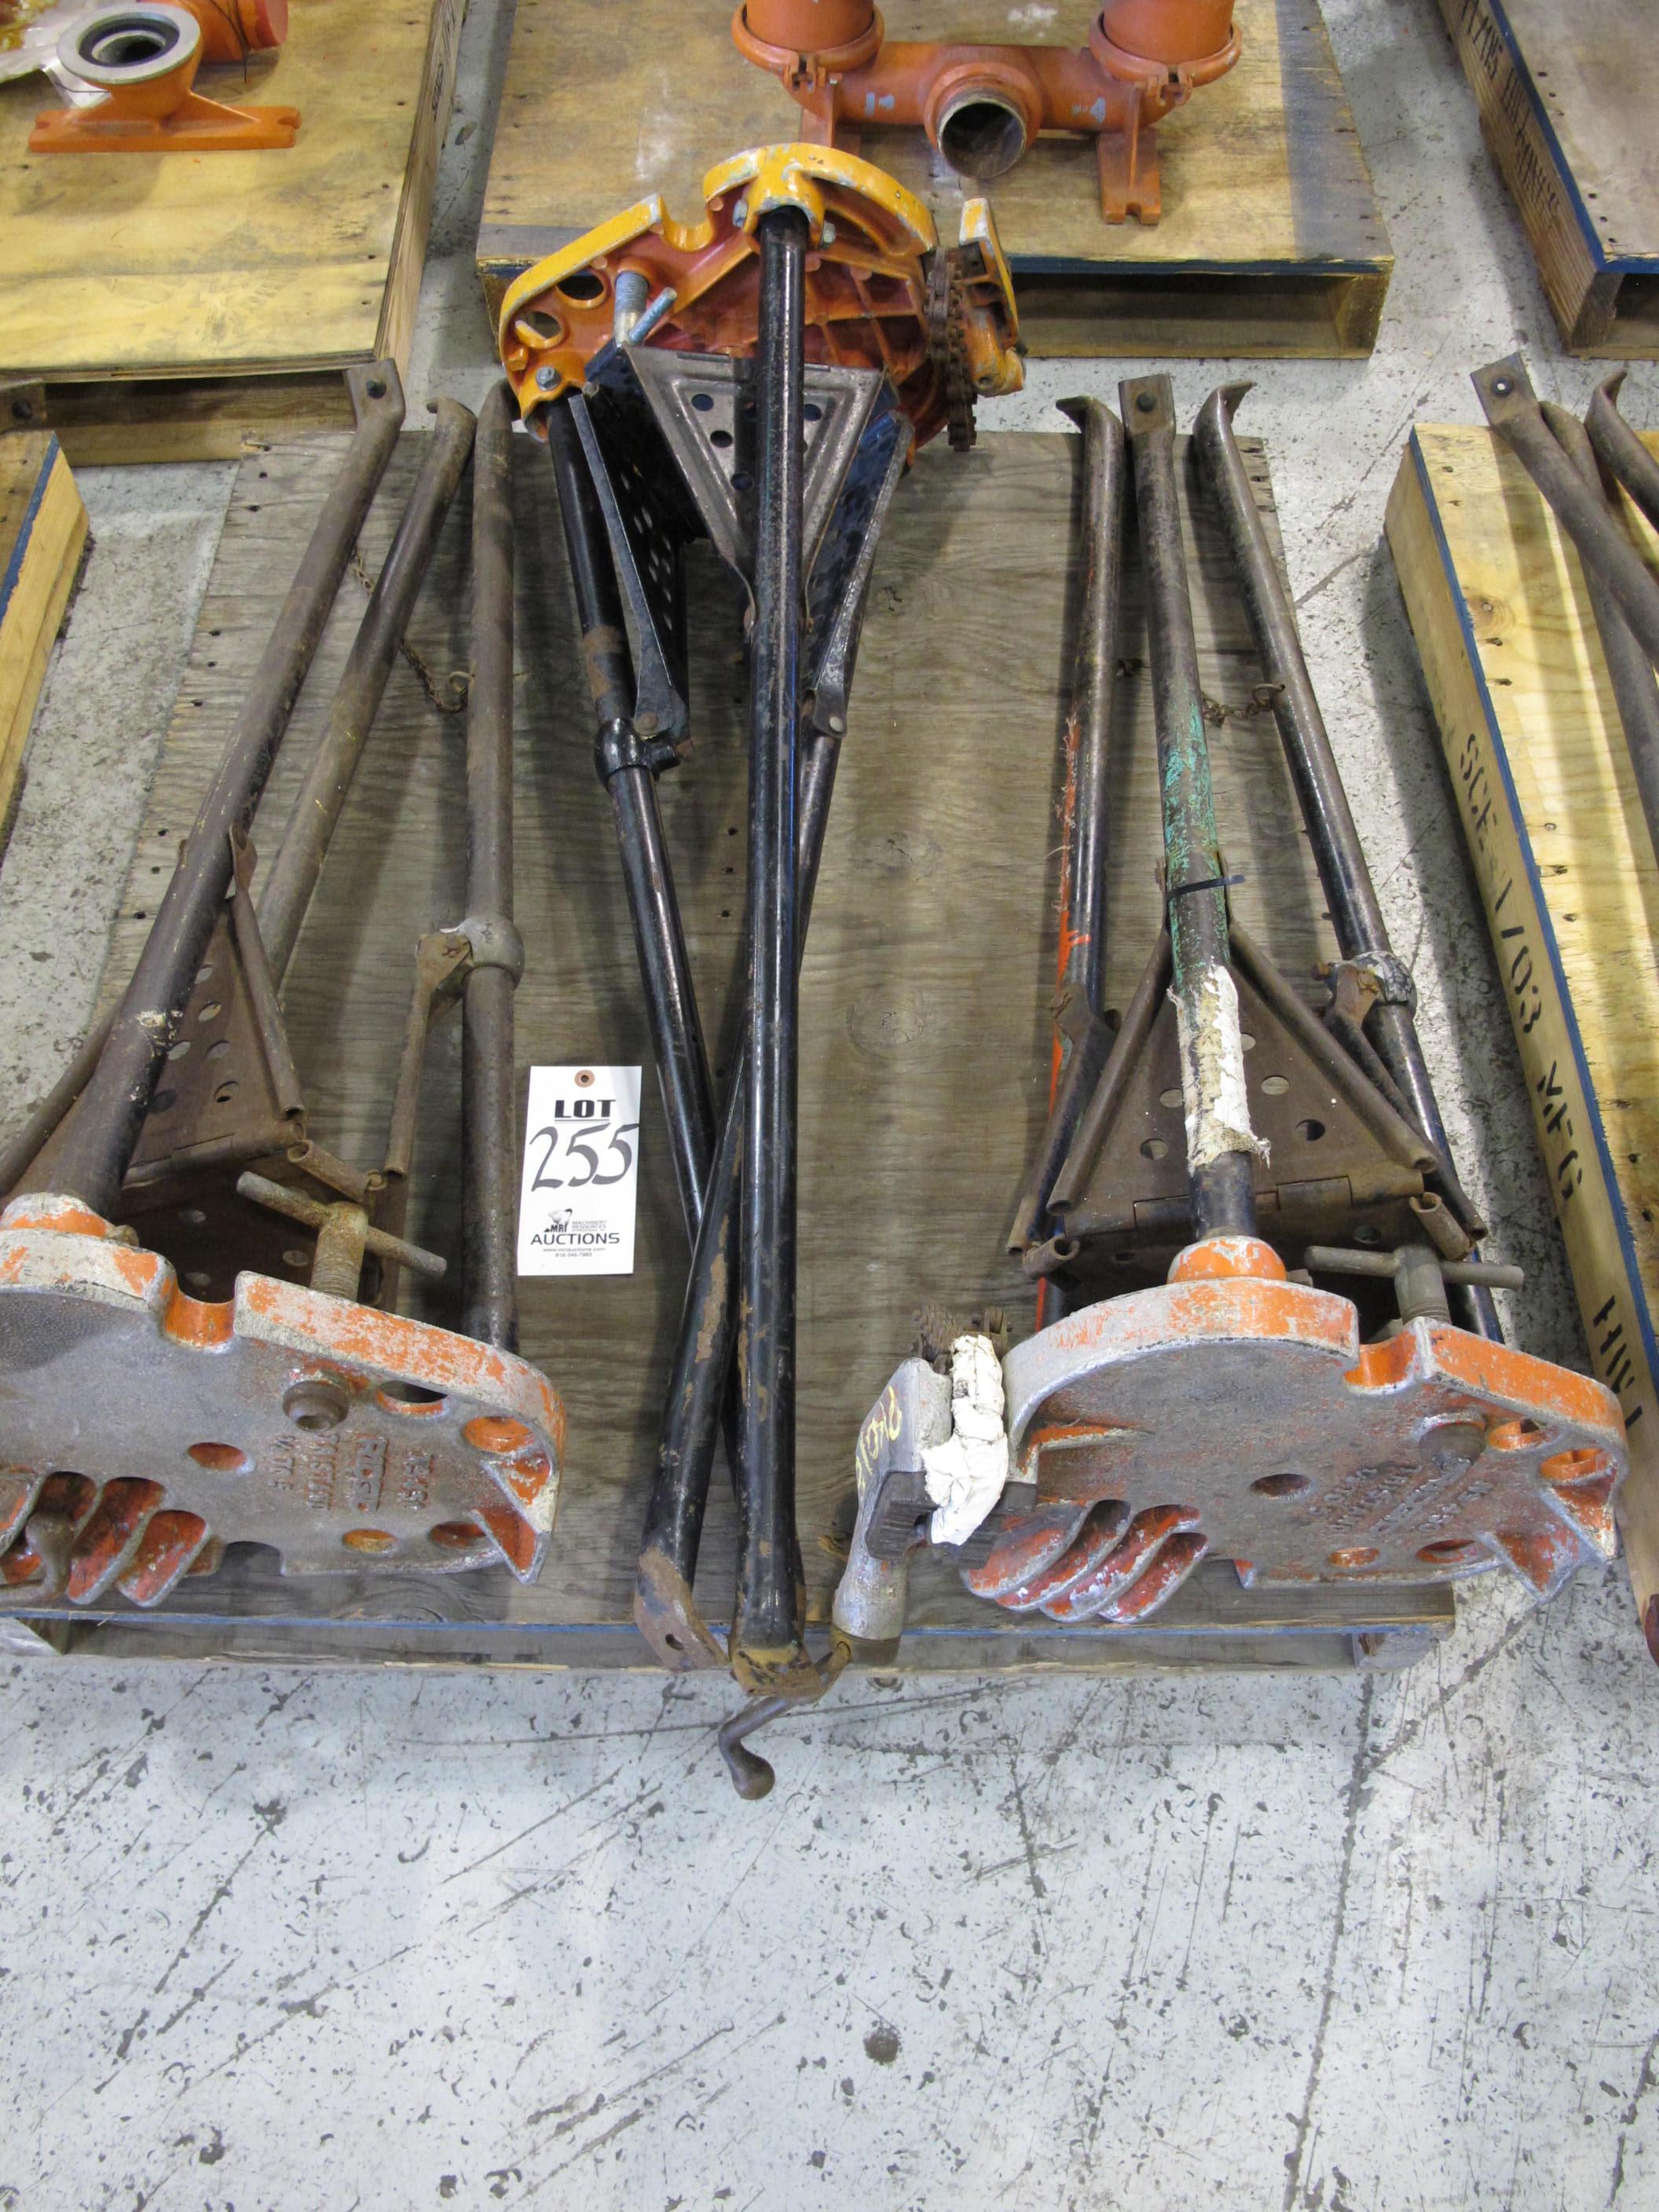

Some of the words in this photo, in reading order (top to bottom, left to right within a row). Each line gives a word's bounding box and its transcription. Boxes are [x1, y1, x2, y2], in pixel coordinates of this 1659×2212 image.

[555, 1100, 616, 1118] LOT
[529, 1122, 639, 1192] 255
[549, 1221, 569, 1232] MRI
[530, 1232, 620, 1245] AUCTIONS
